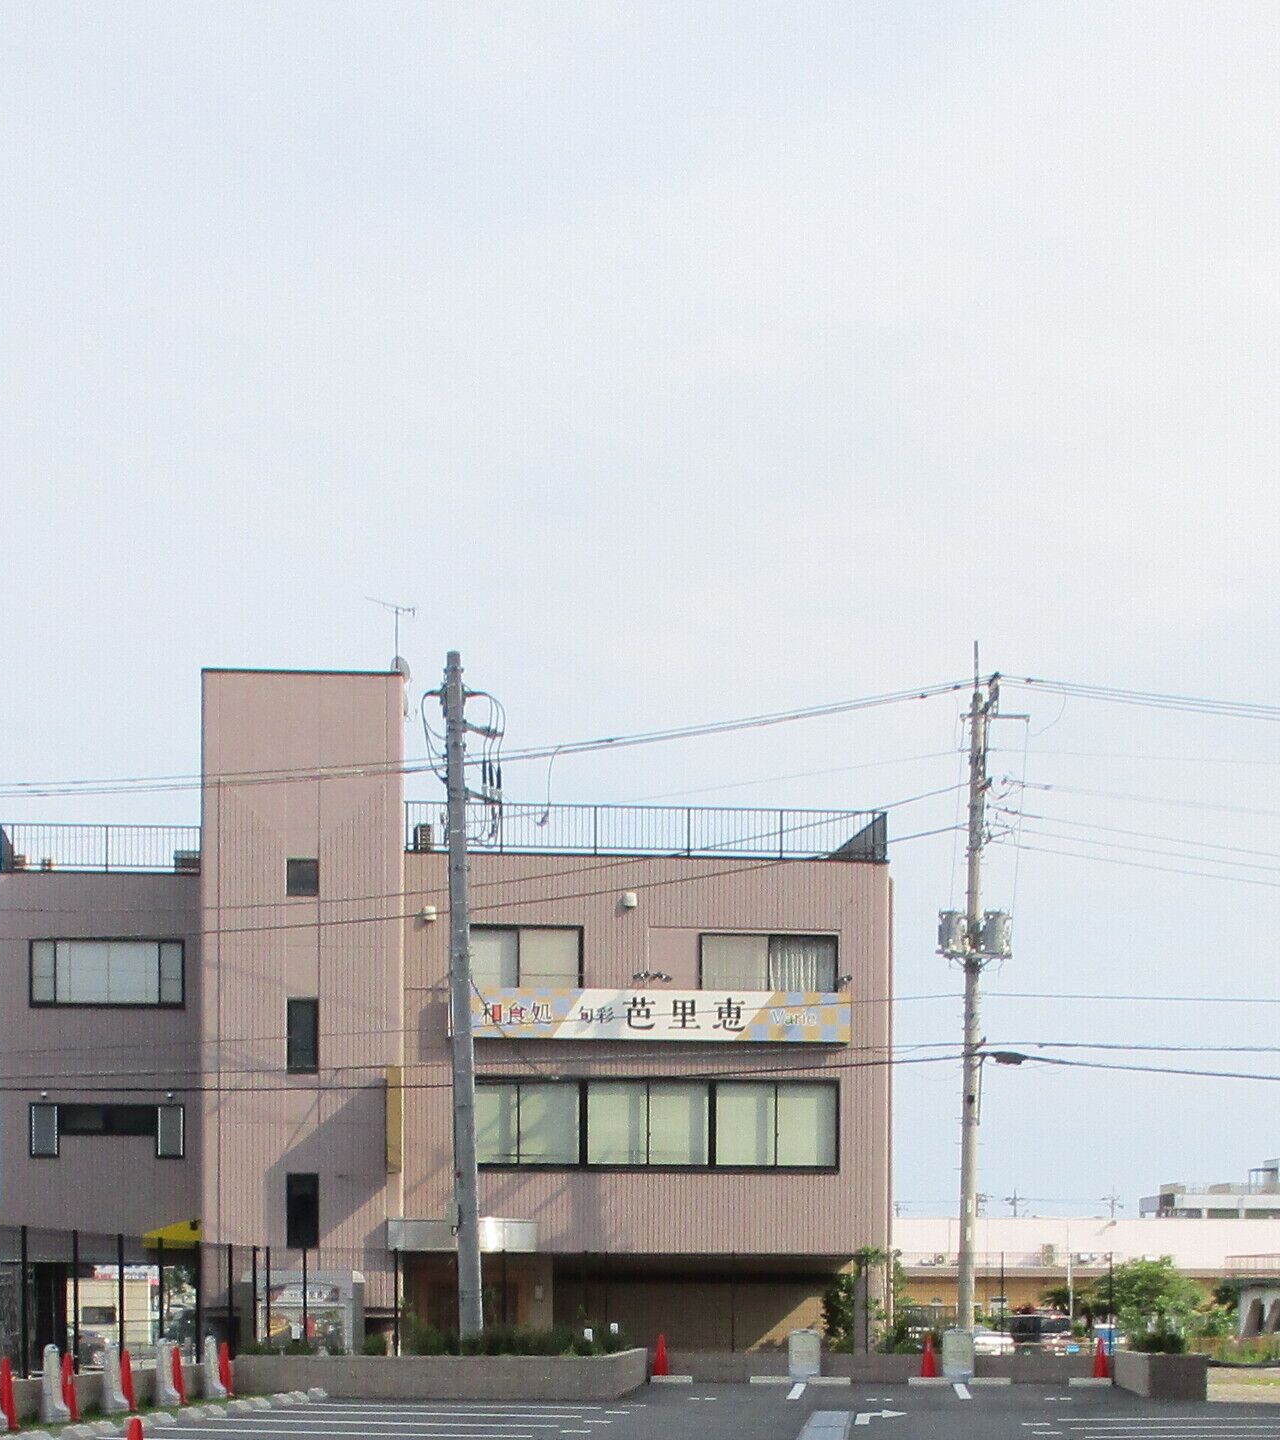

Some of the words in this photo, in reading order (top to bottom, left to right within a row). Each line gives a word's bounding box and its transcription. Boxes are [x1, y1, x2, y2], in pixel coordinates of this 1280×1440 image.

[481, 1001, 553, 1025] 和食処
[578, 1005, 615, 1024] 旬彩
[622, 997, 746, 1032] 芭里恵
[770, 1008, 817, 1026] Varie
